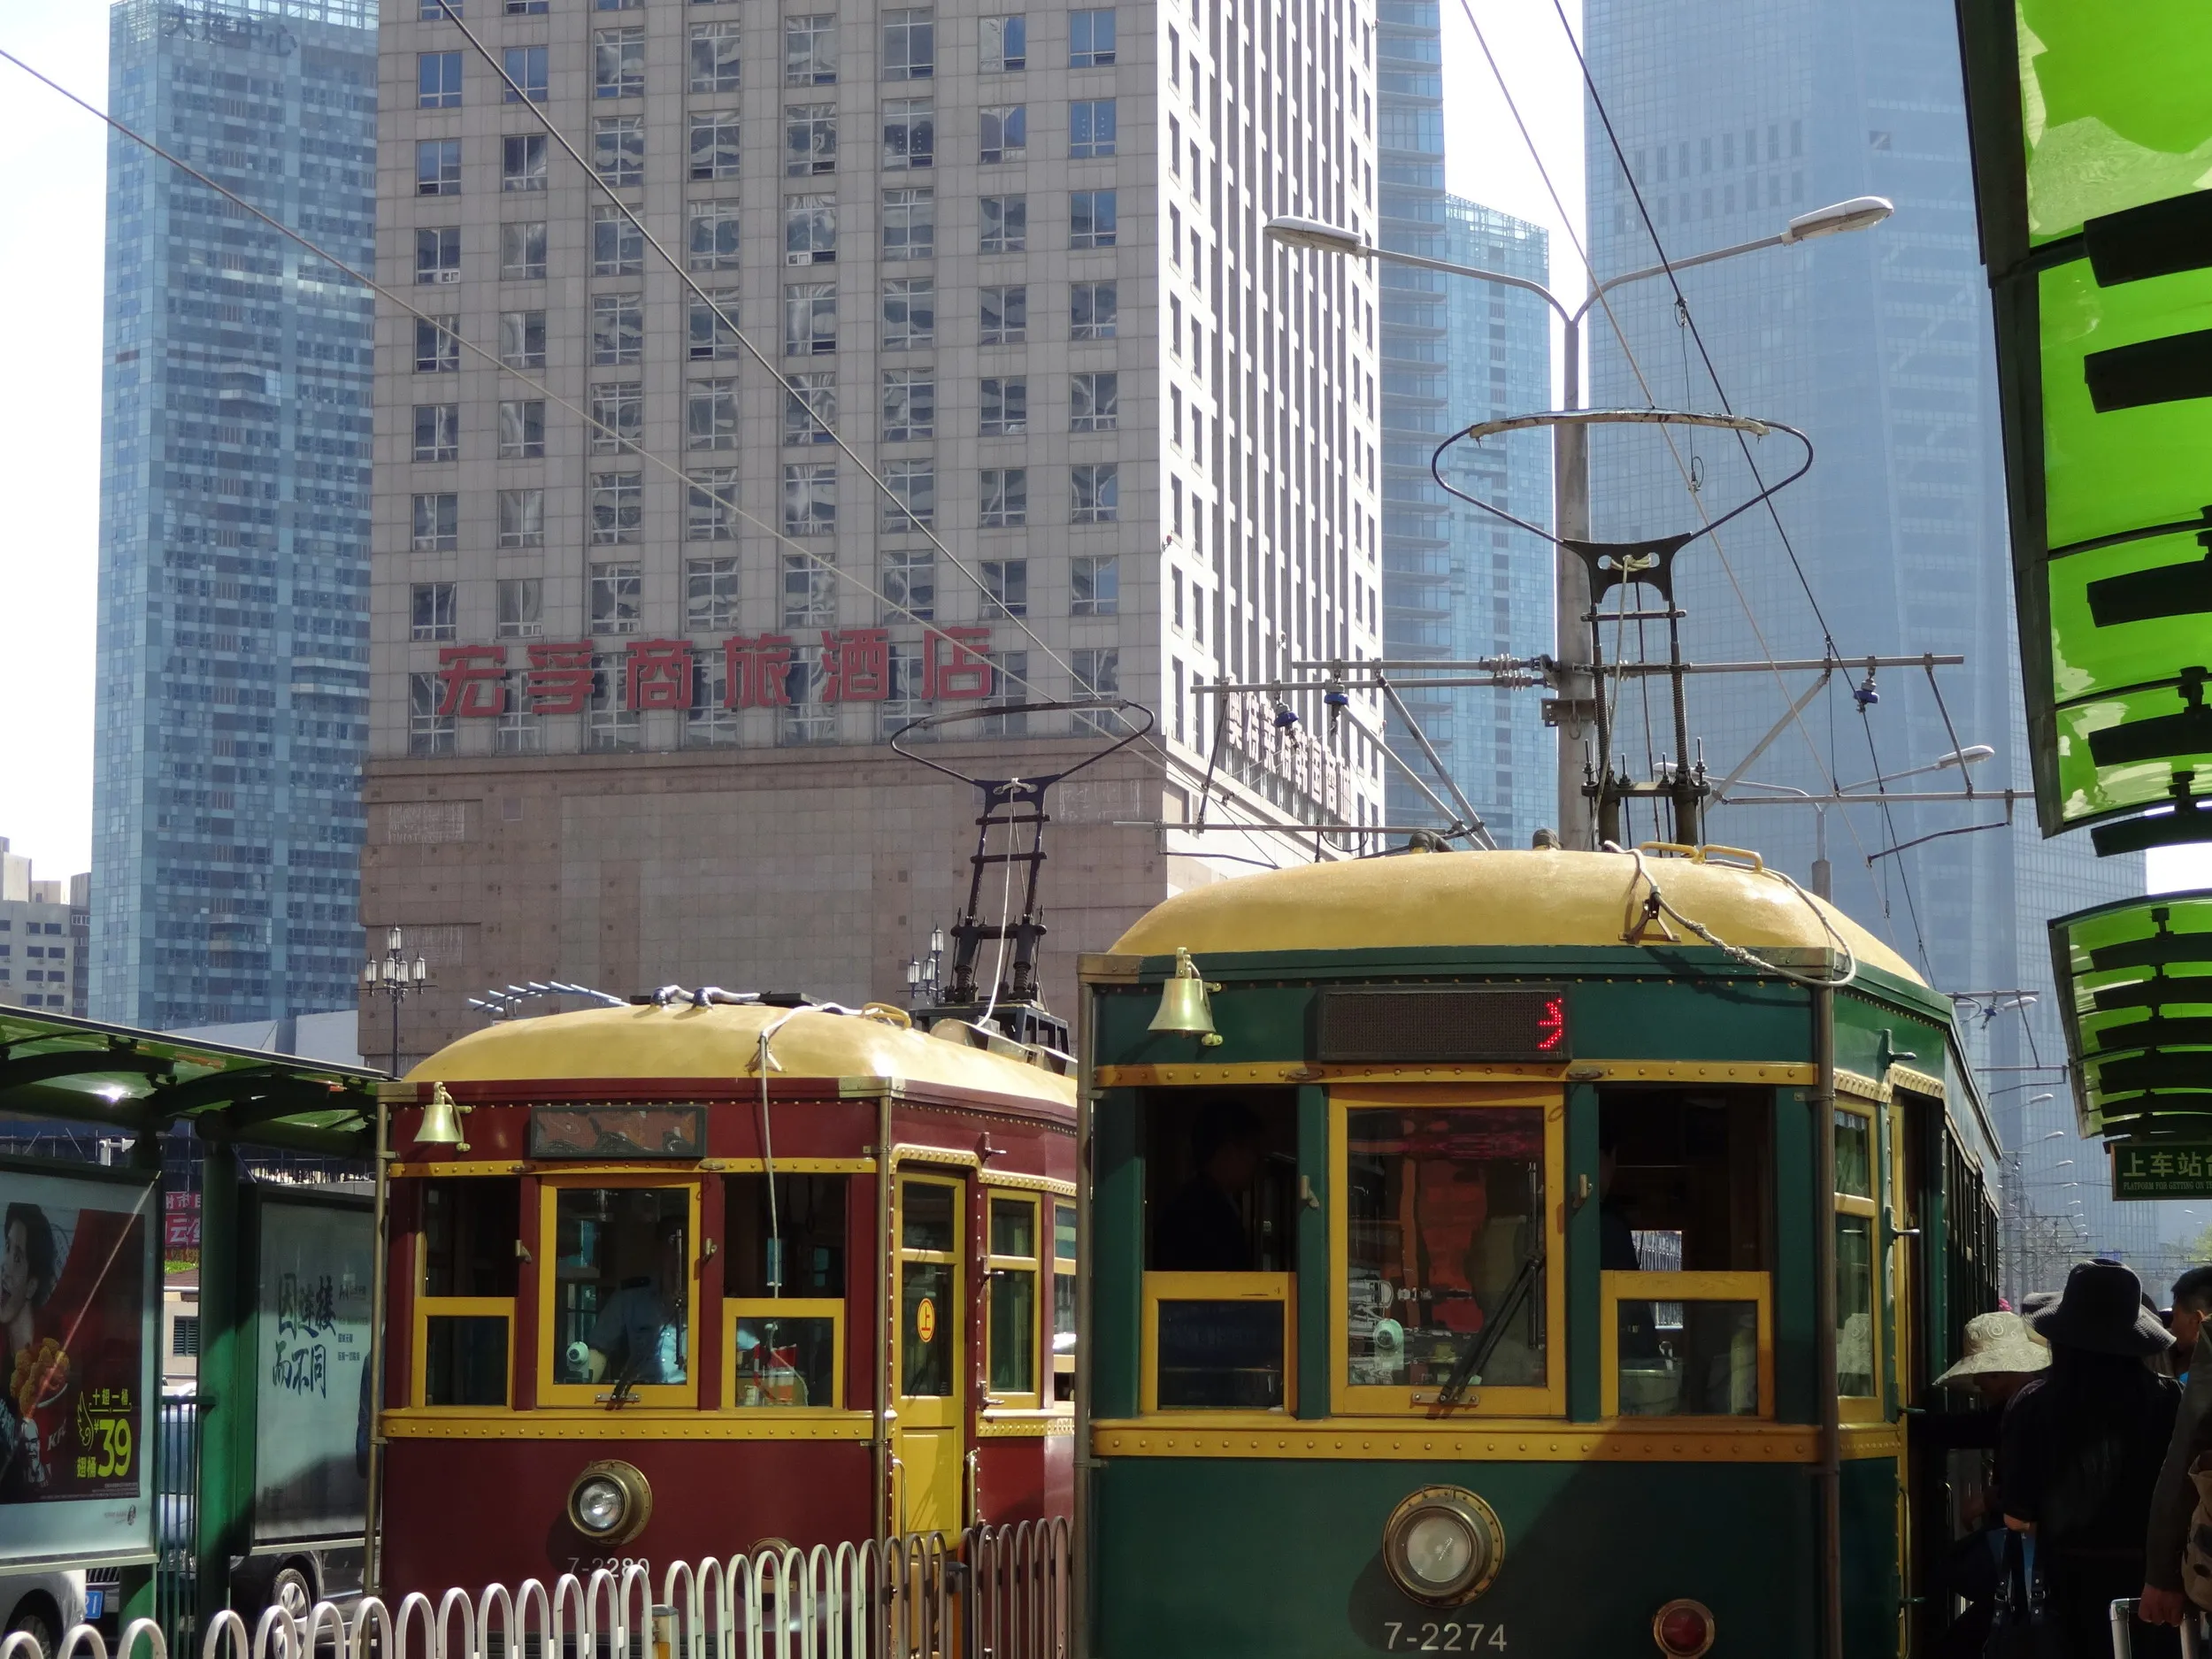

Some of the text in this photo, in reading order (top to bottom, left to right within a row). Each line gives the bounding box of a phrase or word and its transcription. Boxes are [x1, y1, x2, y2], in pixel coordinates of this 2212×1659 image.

[439, 626, 992, 717] 宏孚商旅酒店
[2169, 1181, 2193, 1190] GETTING
[921, 1306, 931, 1331] 上
[1384, 1622, 1508, 1652] 7-2274
